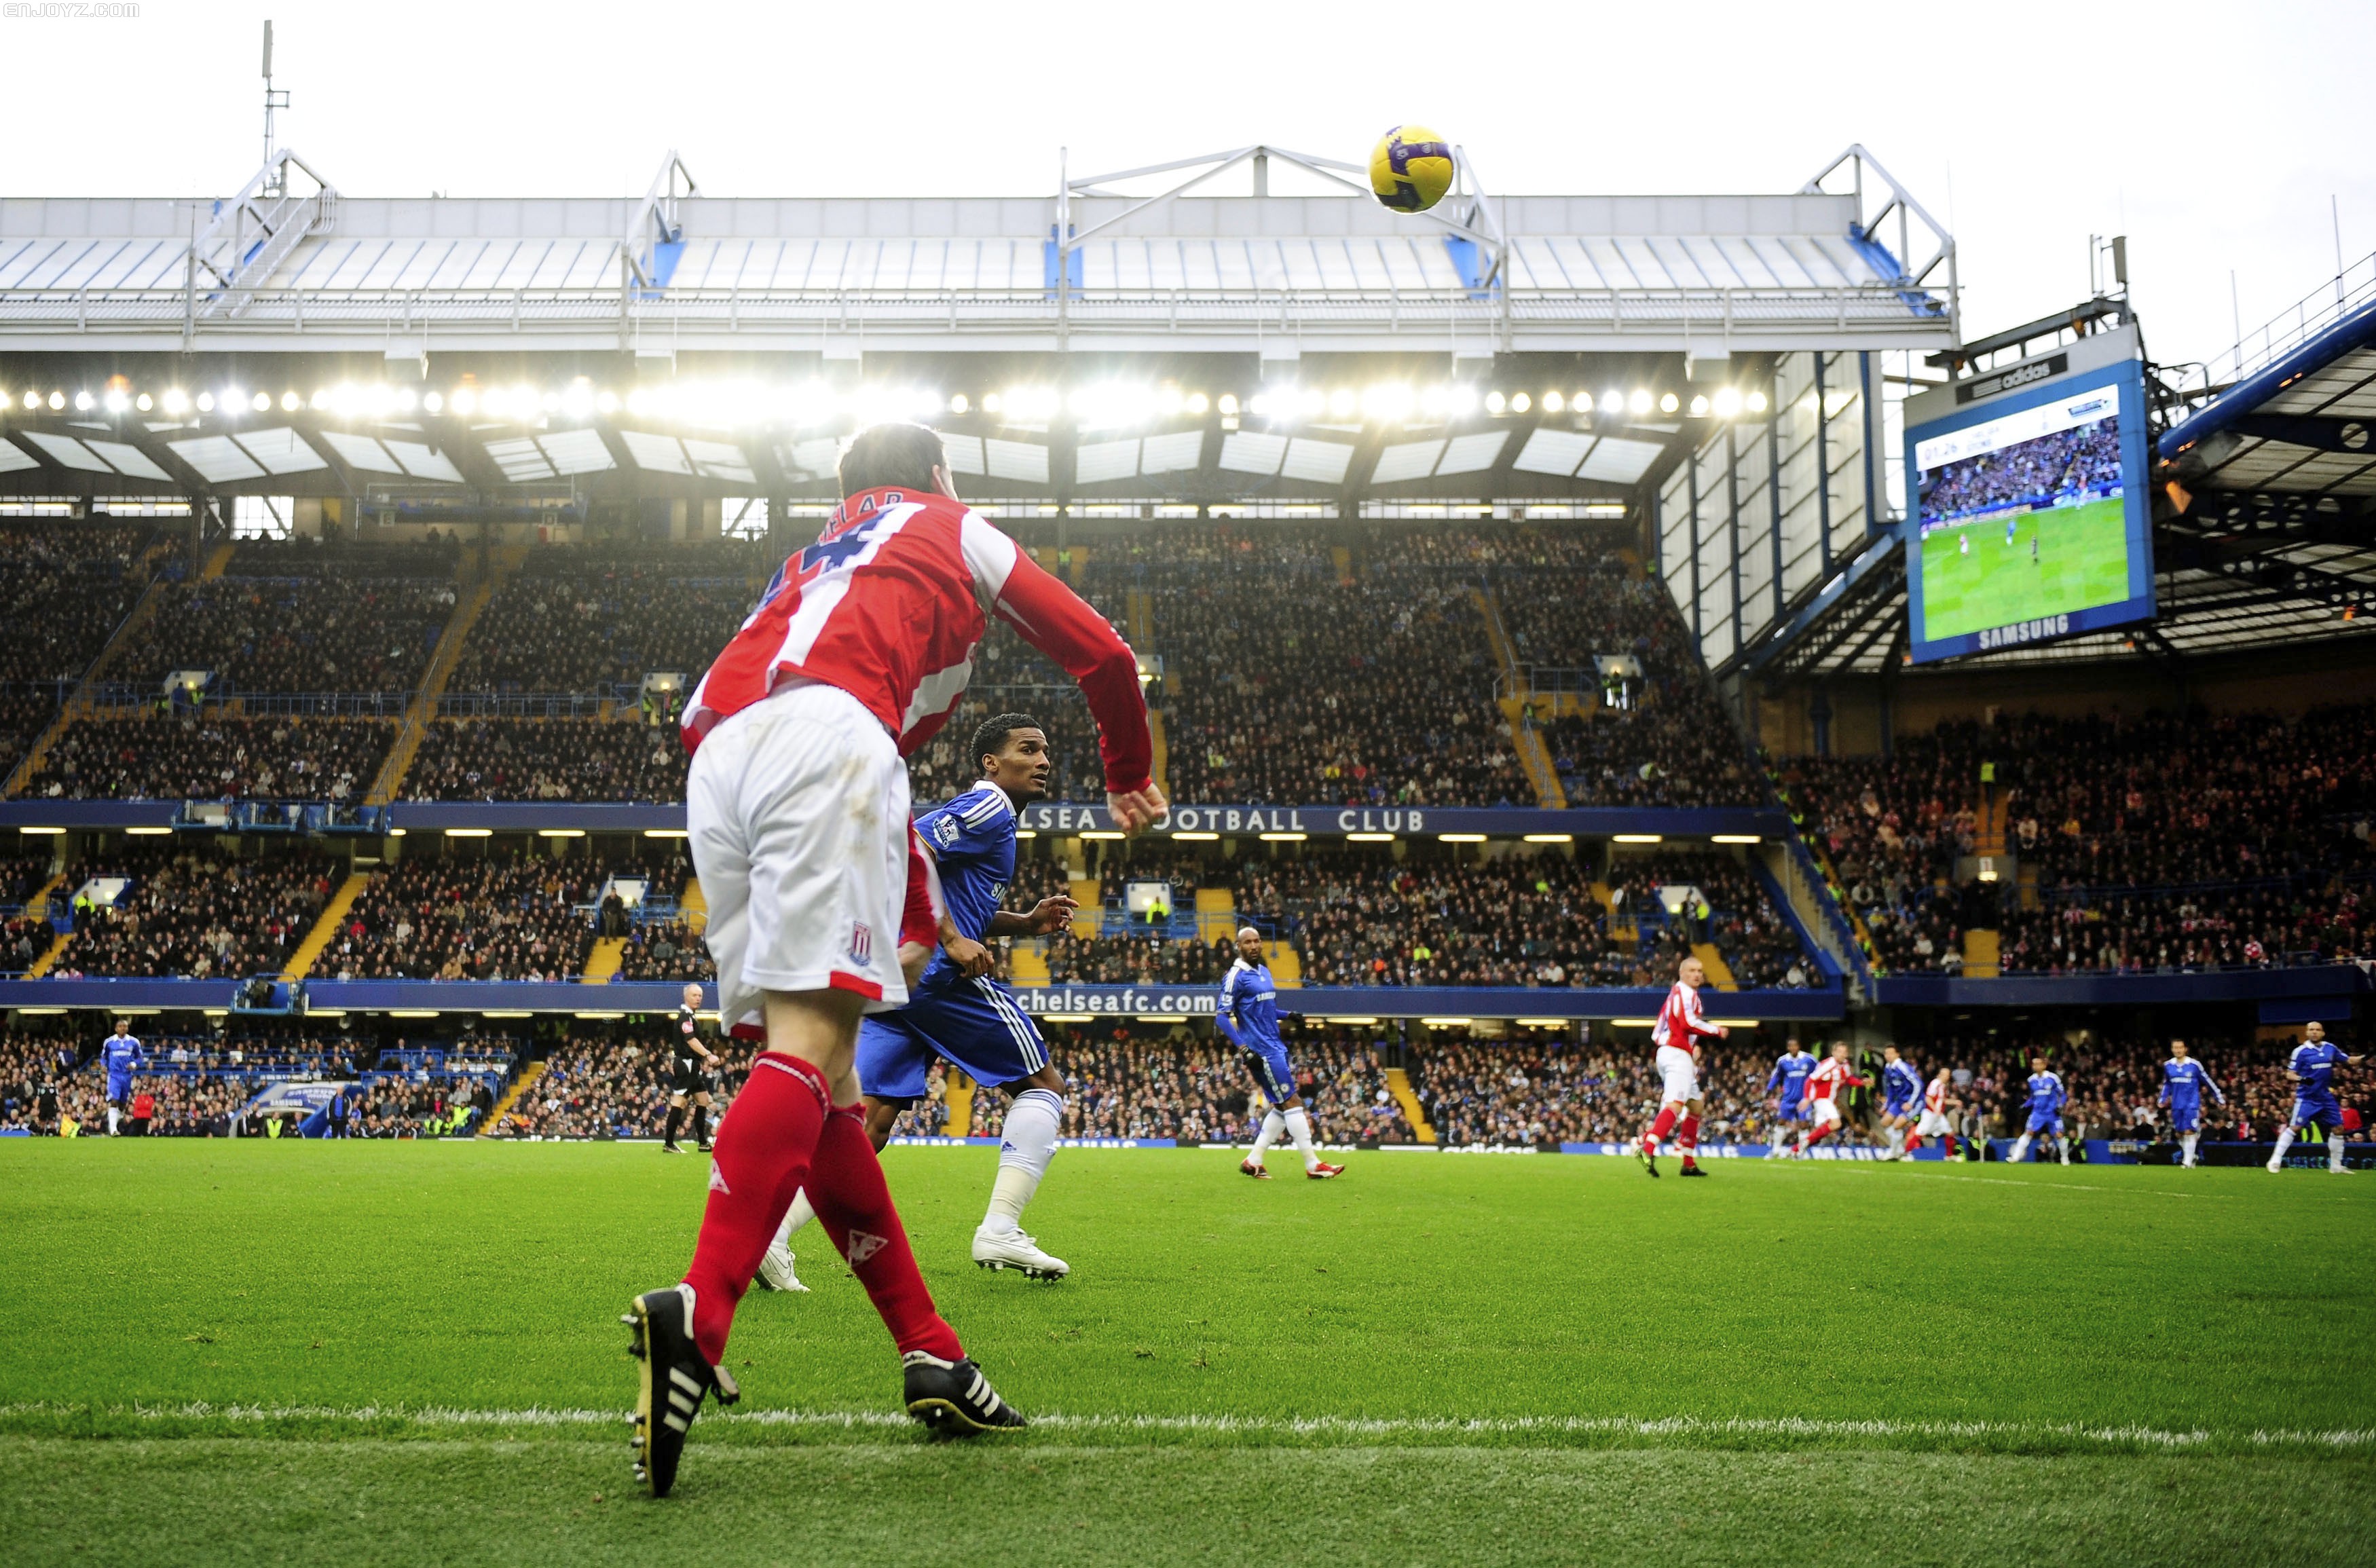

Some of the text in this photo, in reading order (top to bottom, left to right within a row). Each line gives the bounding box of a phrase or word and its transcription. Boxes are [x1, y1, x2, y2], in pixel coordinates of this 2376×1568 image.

[2002, 362, 2050, 389] adidas
[1978, 614, 2069, 650] SAMSUNG
[1338, 810, 1424, 832] CLUB
[1016, 989, 1216, 1012] chelseafc.com
